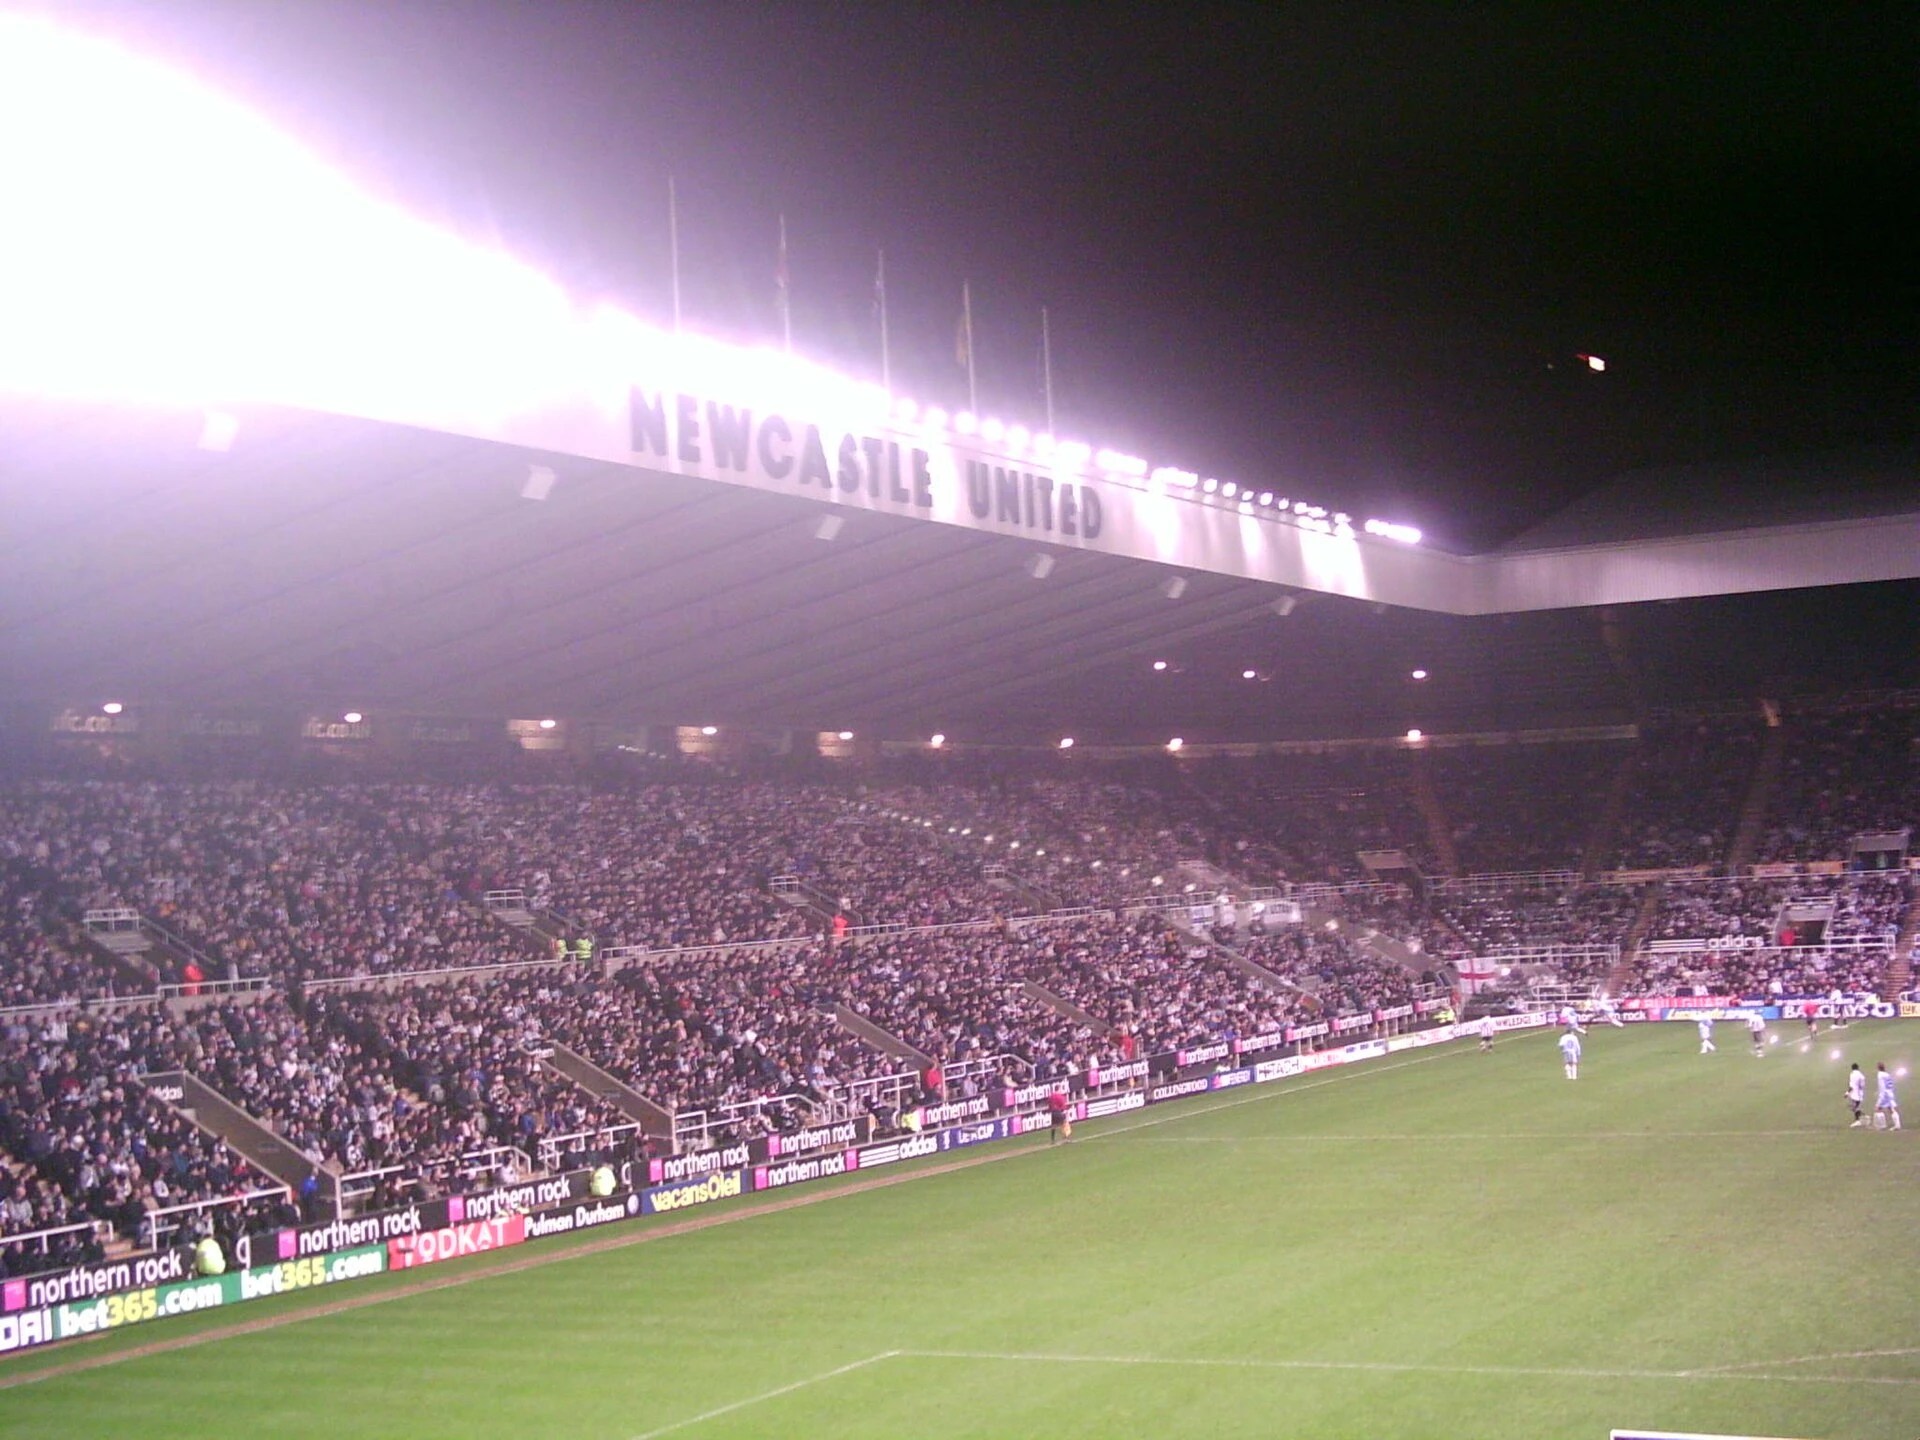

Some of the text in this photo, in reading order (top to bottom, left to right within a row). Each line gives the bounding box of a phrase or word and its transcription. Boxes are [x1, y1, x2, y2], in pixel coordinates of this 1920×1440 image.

[630, 384, 1103, 539] NEWCASTLE UNITED
[1782, 1003, 1869, 1019] BACLYS
[926, 1096, 989, 1124] northern rock
[1014, 1083, 1051, 1104] northern
[781, 1122, 857, 1154] northern rock
[978, 1124, 995, 1140] CUP
[1022, 1111, 1052, 1133] northe
[664, 1141, 749, 1179] northern rock
[900, 1136, 938, 1159] adidas
[768, 1153, 845, 1187] northern rock
[466, 1176, 571, 1219] northern rock
[300, 1205, 421, 1255] northern rock
[524, 1201, 625, 1238] Pulman Durham
[397, 1217, 509, 1268] VODKAT
[30, 1249, 183, 1306] northern rock
[241, 1251, 382, 1299] bet365.com
[59, 1282, 223, 1338] bet365.com
